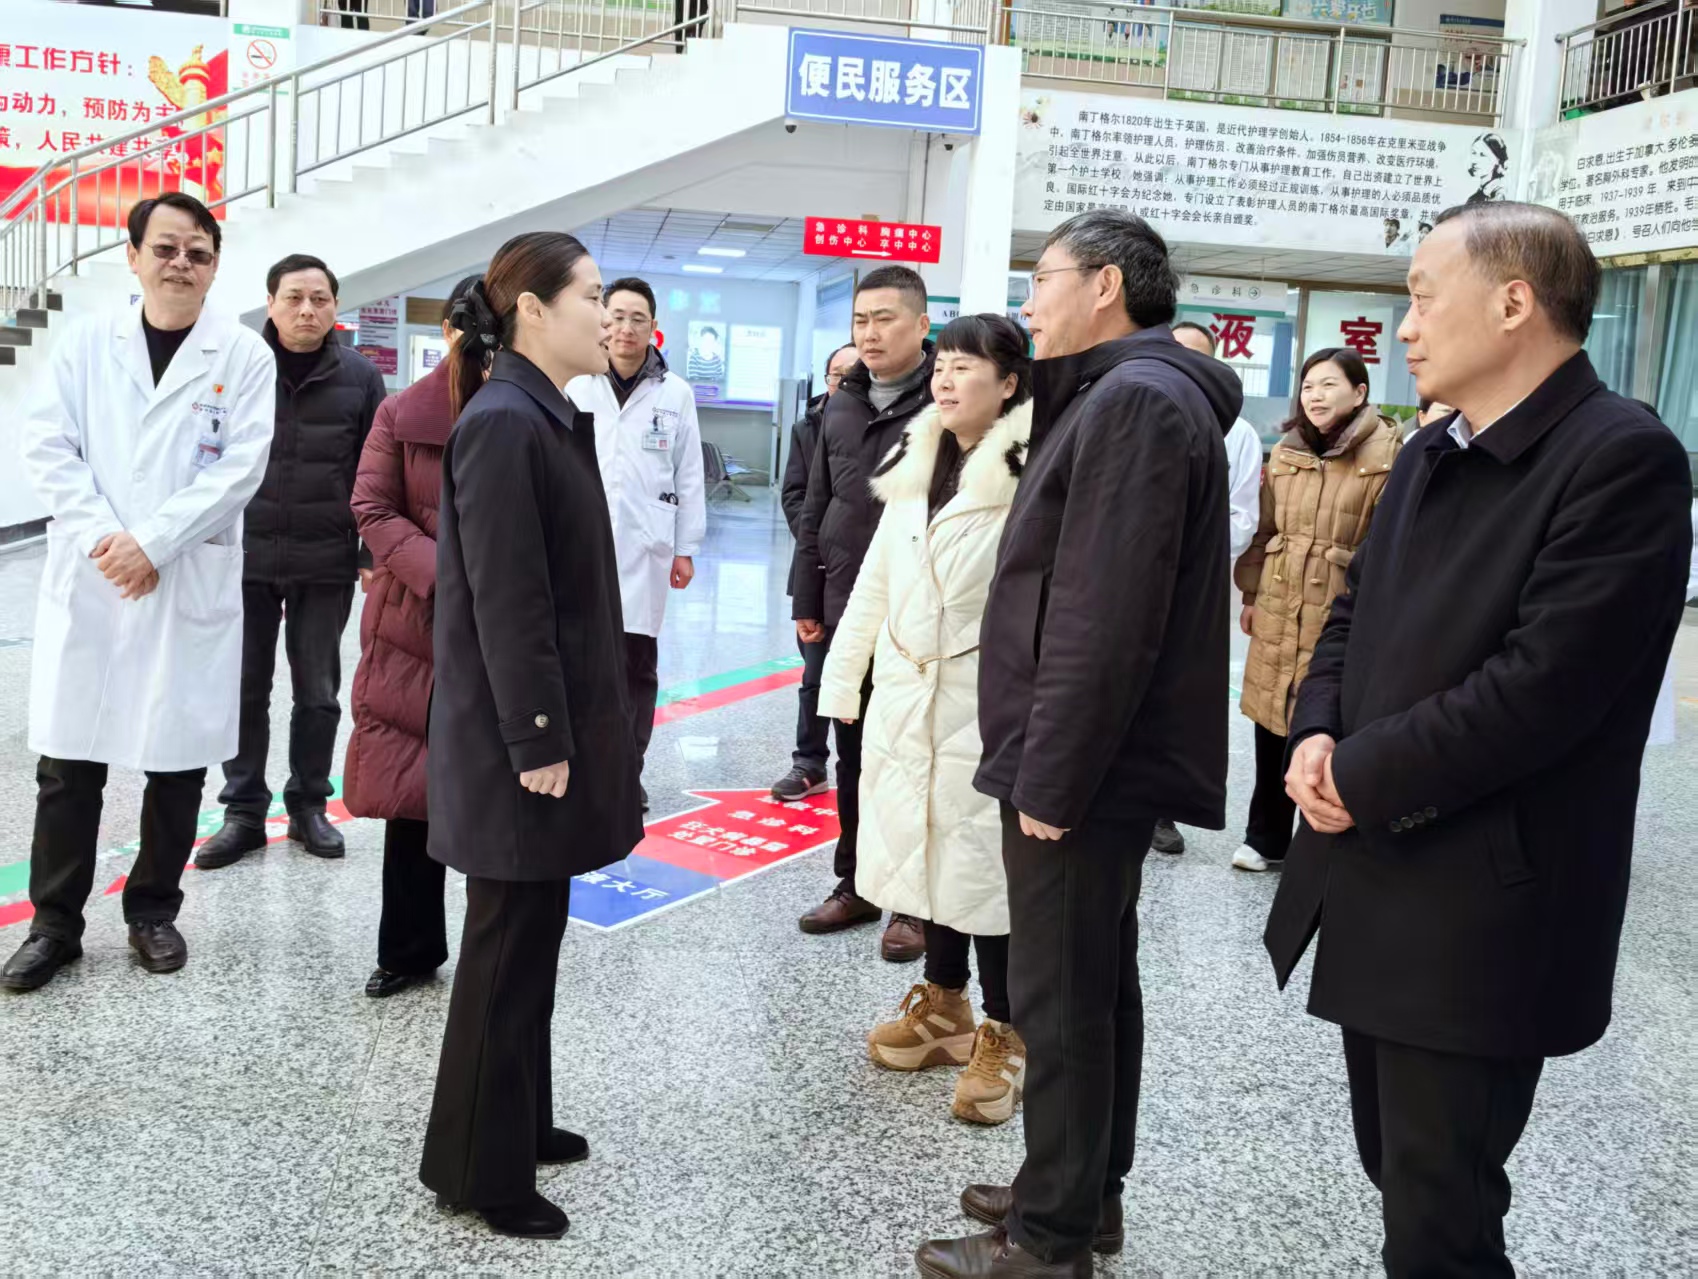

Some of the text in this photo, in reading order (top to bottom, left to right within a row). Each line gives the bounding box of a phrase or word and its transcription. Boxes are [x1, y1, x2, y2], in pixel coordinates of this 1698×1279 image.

[798, 53, 972, 109] 便民服务区
[815, 221, 869, 235] 急诊科
[814, 234, 932, 252] 创伤中心 卒中中心
